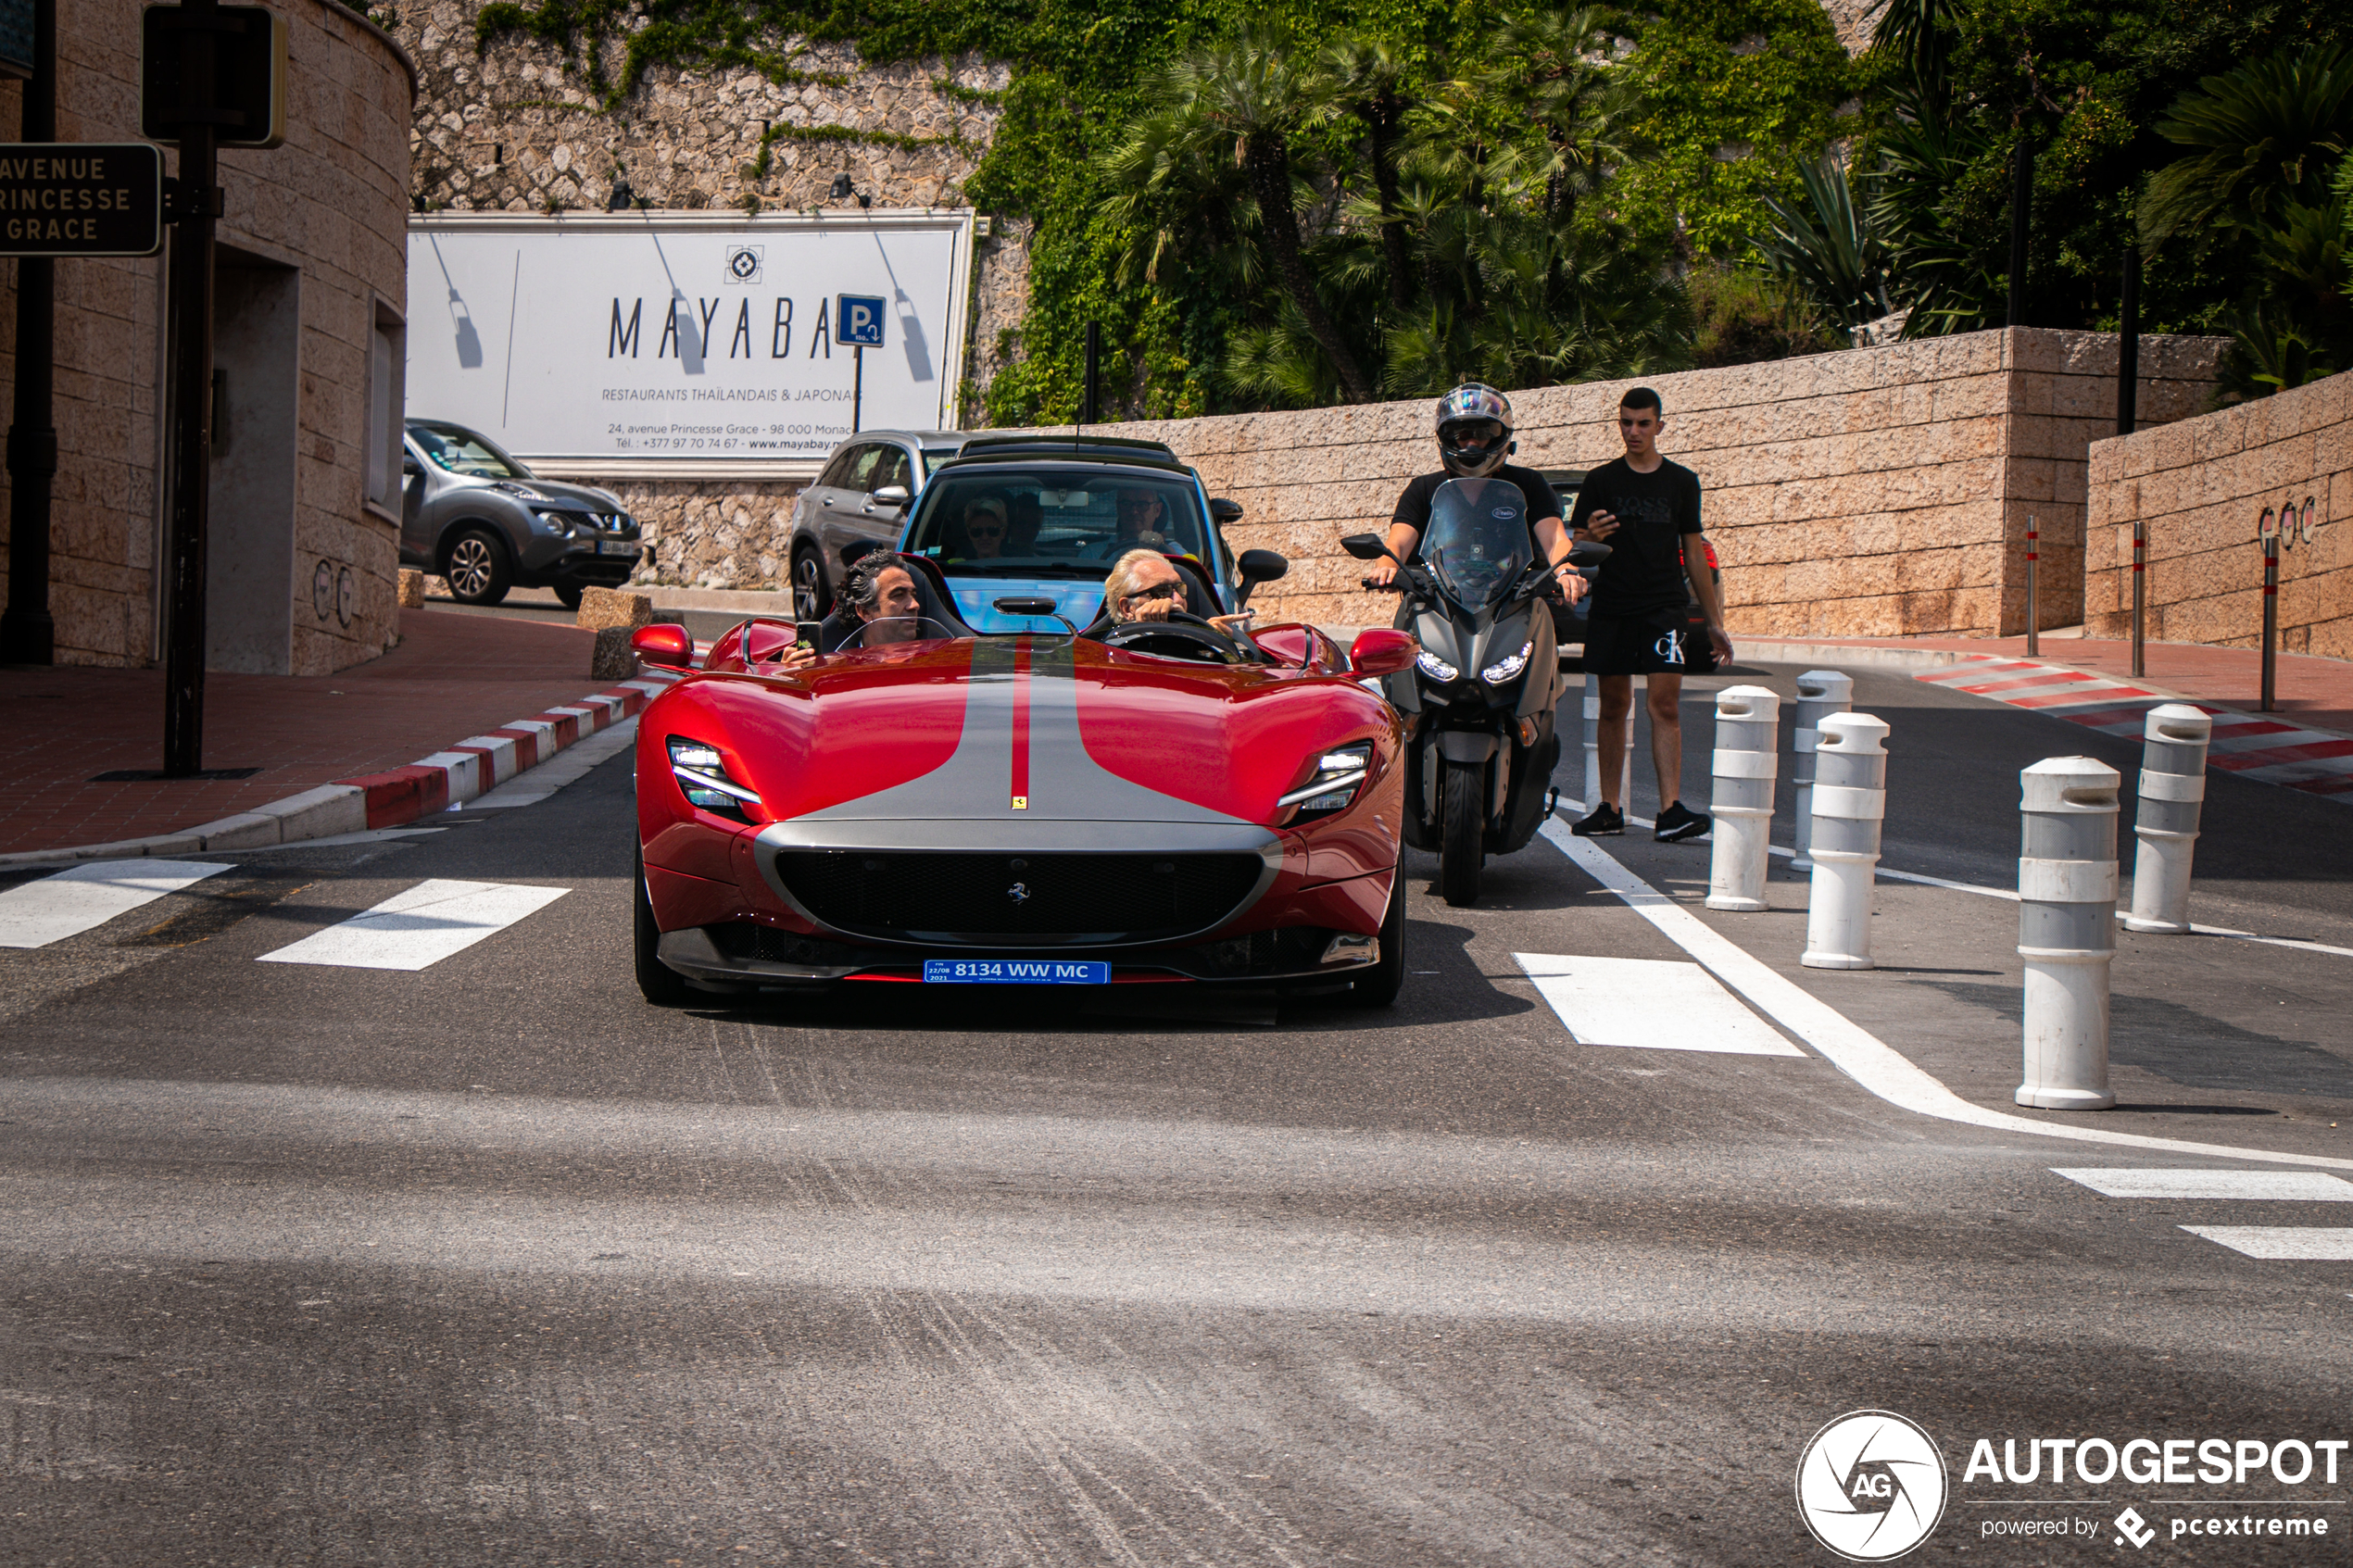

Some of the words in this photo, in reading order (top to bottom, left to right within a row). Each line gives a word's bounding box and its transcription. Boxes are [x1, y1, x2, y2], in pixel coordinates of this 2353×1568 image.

[0, 158, 105, 180] AVENUE
[7, 219, 97, 240] GRACE
[609, 297, 858, 358] MAYABA
[851, 305, 872, 334] P
[602, 389, 687, 401] RESTAURANTS
[692, 386, 777, 401] THAÏLANDAIS
[782, 389, 790, 401] &
[609, 423, 624, 434] 24,
[671, 424, 723, 433] Princesse
[726, 424, 759, 434] Grace
[770, 424, 784, 434] 98
[787, 424, 812, 434] 000
[815, 425, 854, 434] Monac
[643, 438, 669, 448] +377
[673, 438, 686, 448] 97
[690, 438, 704, 448] 70
[708, 438, 721, 448] 74
[724, 438, 738, 448] 67
[955, 963, 1002, 976] 8134
[1008, 963, 1051, 977] WW
[1056, 964, 1088, 978] MC
